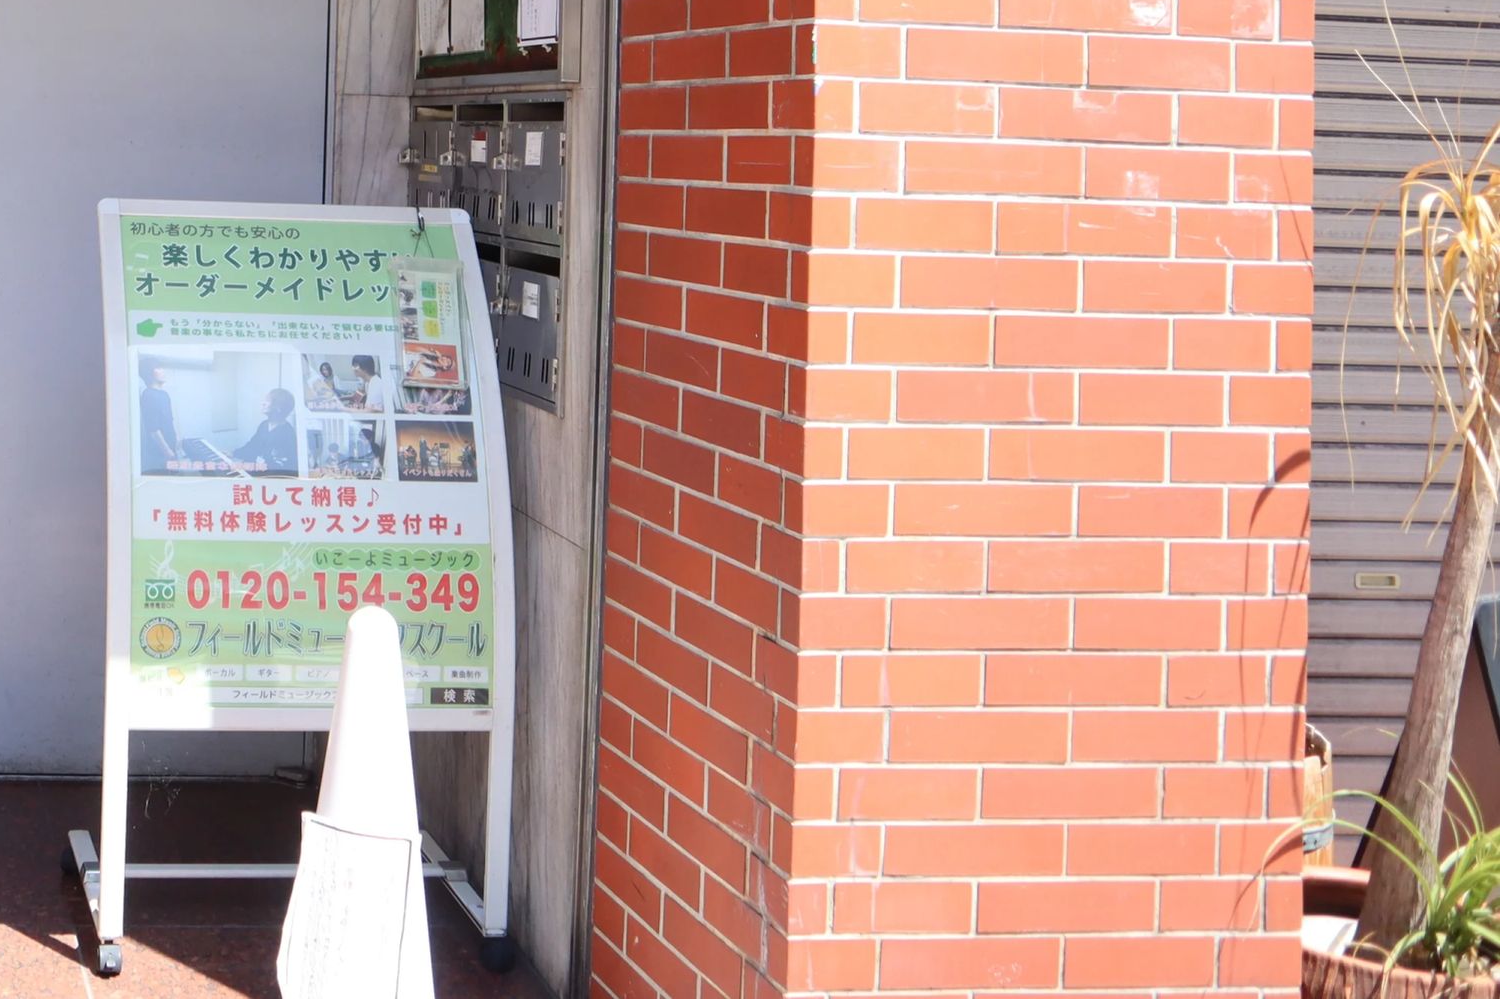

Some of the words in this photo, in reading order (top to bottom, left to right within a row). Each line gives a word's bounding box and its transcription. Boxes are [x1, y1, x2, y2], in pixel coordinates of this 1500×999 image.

[130, 222, 301, 240] 初心者の方でも安心の
[162, 243, 411, 272] 楽しくわかりやす
[315, 550, 475, 568] いこーよミュージック
[186, 570, 481, 613] 0120-154-349
[443, 688, 476, 703] 検索
